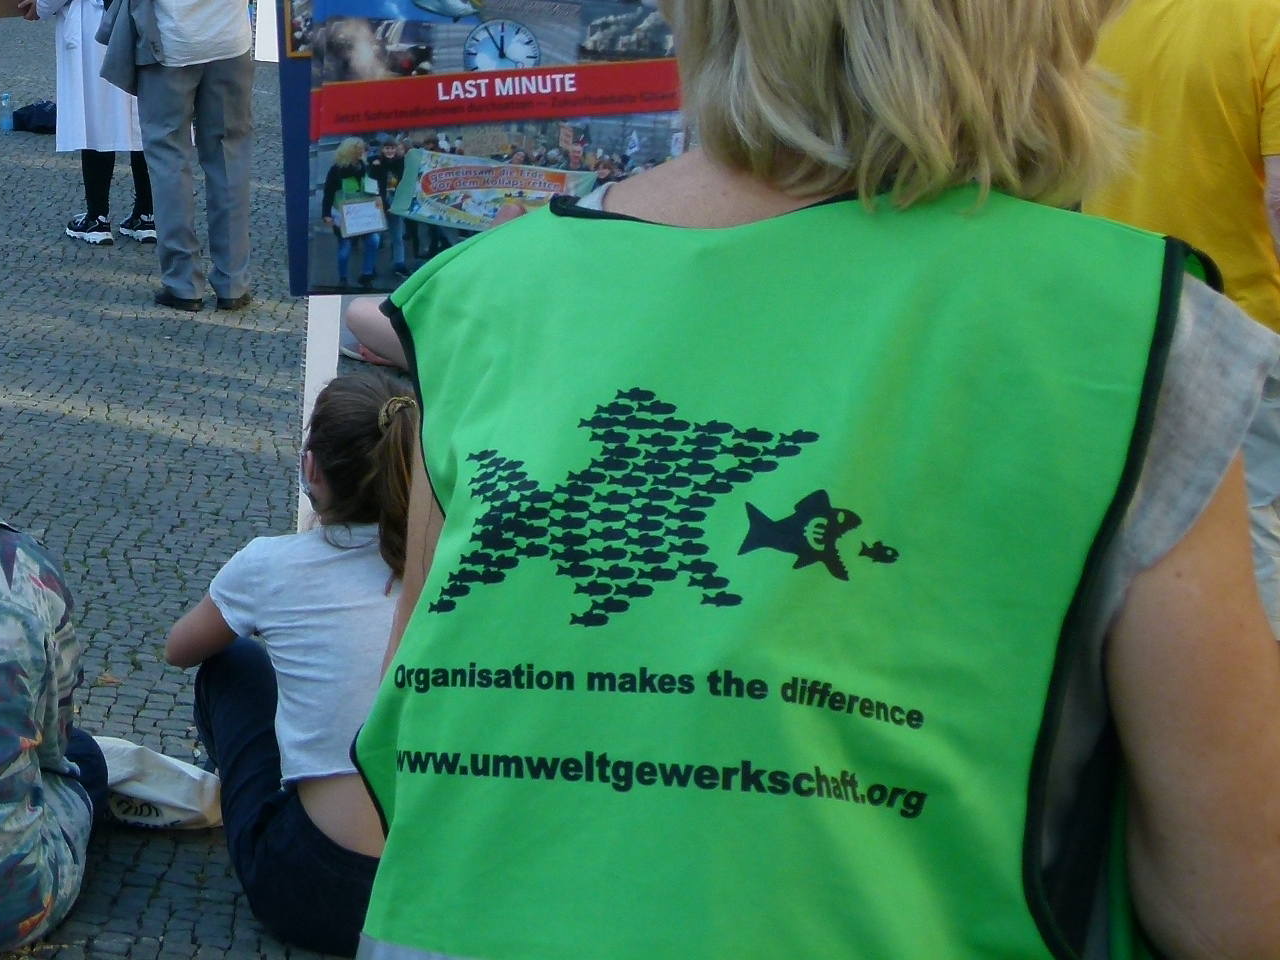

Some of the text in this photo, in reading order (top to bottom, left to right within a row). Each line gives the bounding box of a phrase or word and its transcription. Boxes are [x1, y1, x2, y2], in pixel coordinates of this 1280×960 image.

[437, 73, 577, 101] LAST MINUTE
[394, 662, 924, 729] Organisation makes the difference
[397, 749, 927, 819] www.umweltgewerkschaft.org
